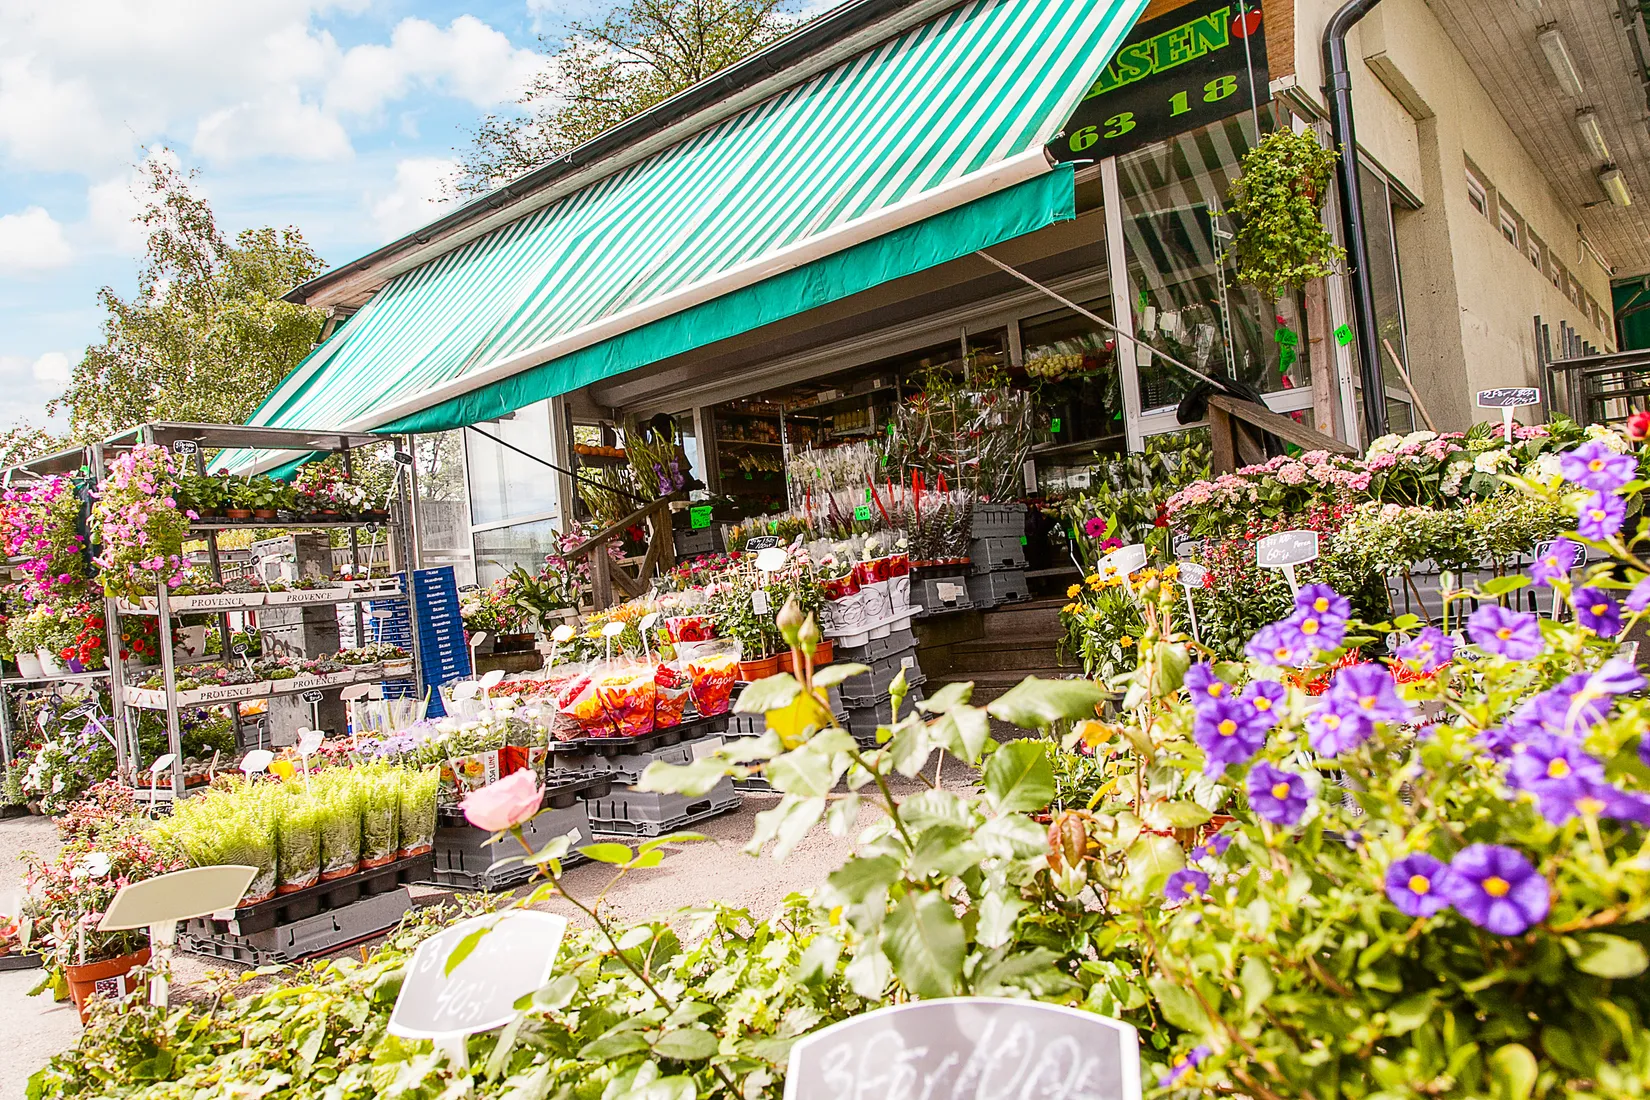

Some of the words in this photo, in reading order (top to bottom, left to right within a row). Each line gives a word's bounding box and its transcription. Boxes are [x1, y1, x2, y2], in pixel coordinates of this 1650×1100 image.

[1069, 112, 1137, 152] 63
[1168, 75, 1238, 118] 18
[191, 597, 244, 607] PROVENCE
[286, 592, 333, 602] PROVENCE
[293, 676, 339, 688] PROVENCE
[200, 687, 252, 700] PROVENCE
